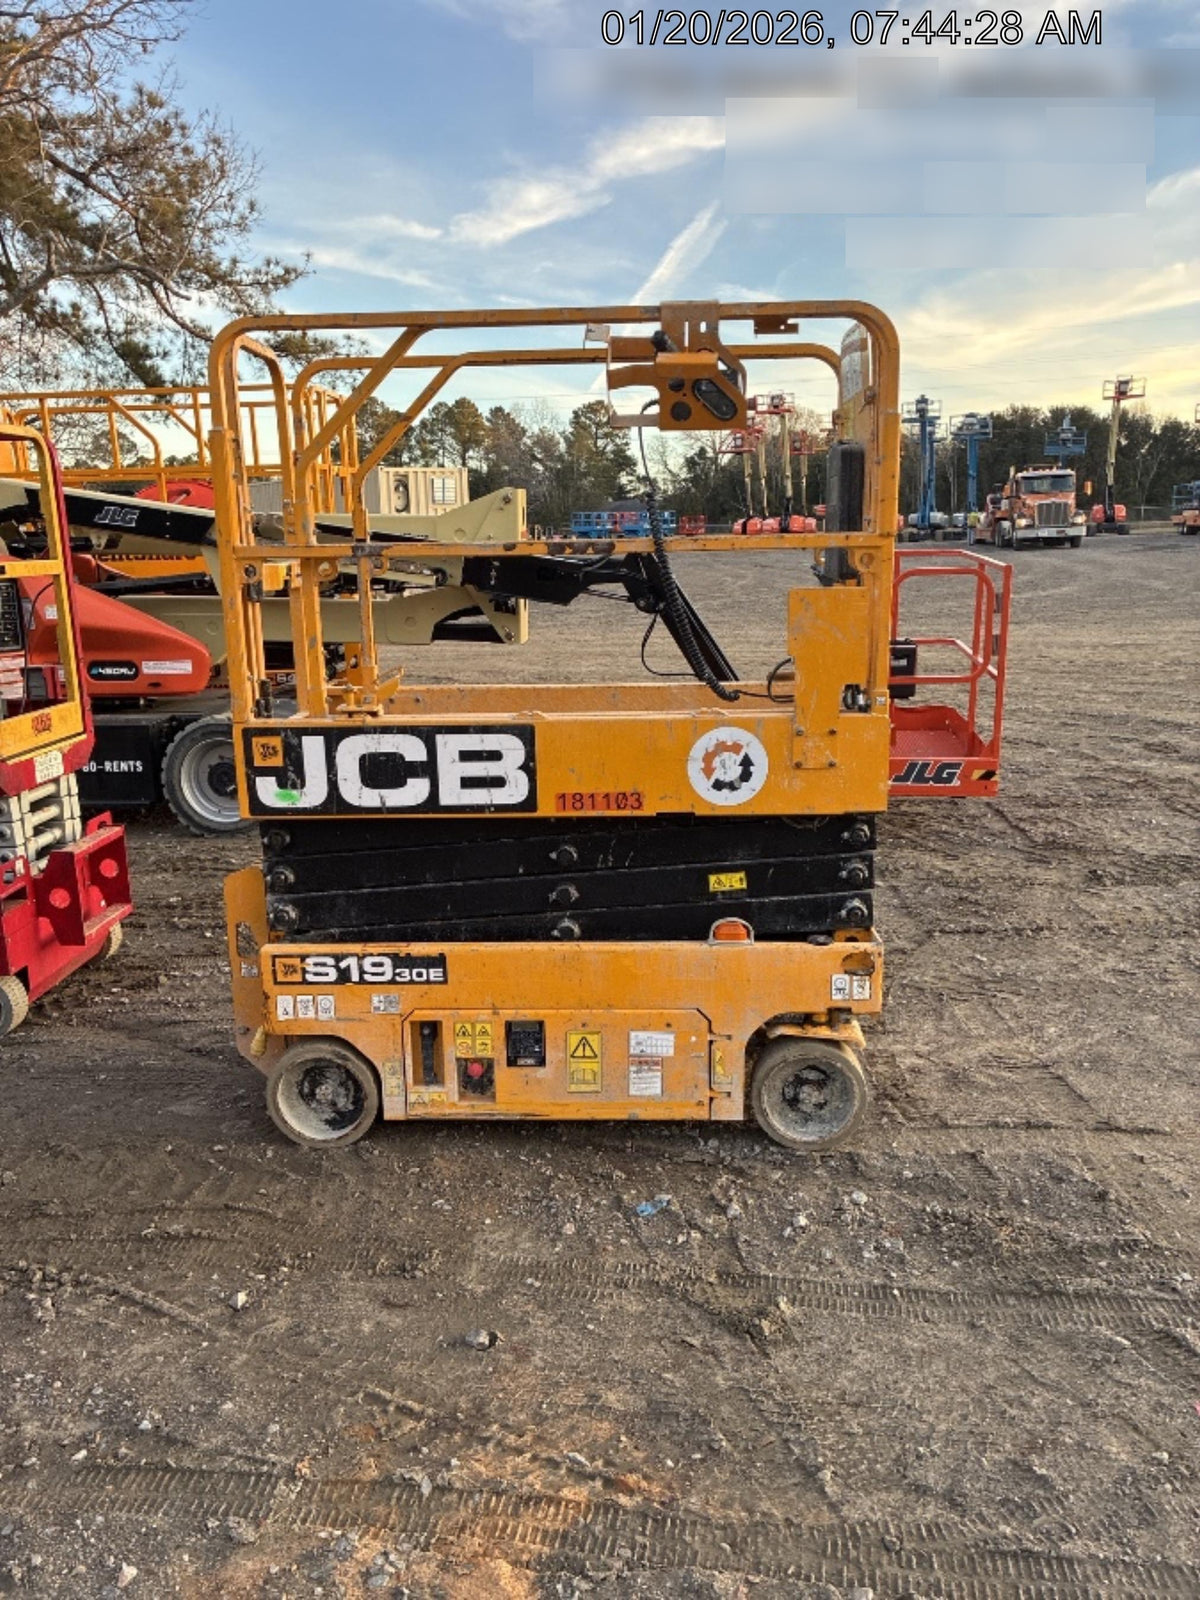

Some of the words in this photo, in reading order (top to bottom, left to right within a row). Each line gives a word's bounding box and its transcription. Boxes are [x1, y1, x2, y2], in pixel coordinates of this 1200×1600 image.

[93, 505, 140, 528] JLG
[254, 733, 530, 808] JCB
[889, 760, 964, 787] JLG
[558, 792, 643, 811] 181103
